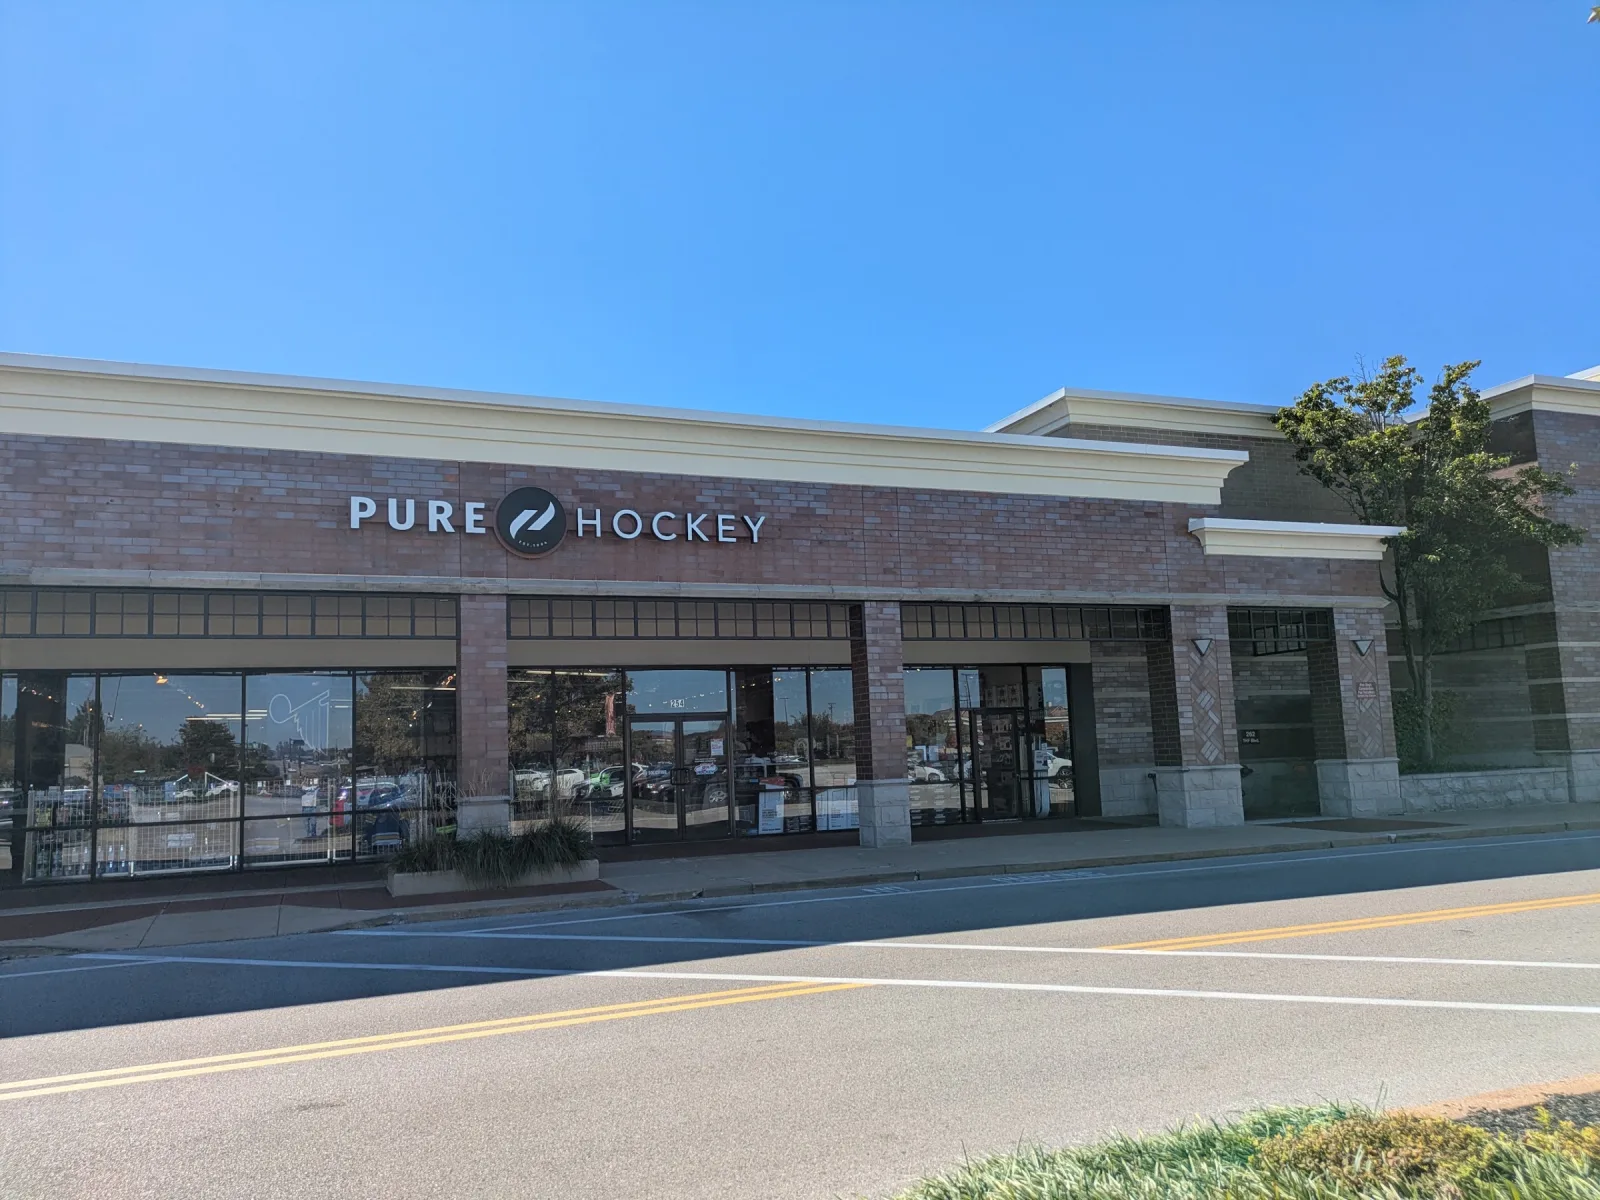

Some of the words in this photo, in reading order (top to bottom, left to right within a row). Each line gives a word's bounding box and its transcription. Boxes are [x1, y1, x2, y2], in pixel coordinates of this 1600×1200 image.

[351, 497, 485, 533] PURE
[578, 508, 765, 542] HOCKEY
[671, 699, 685, 708] 254
